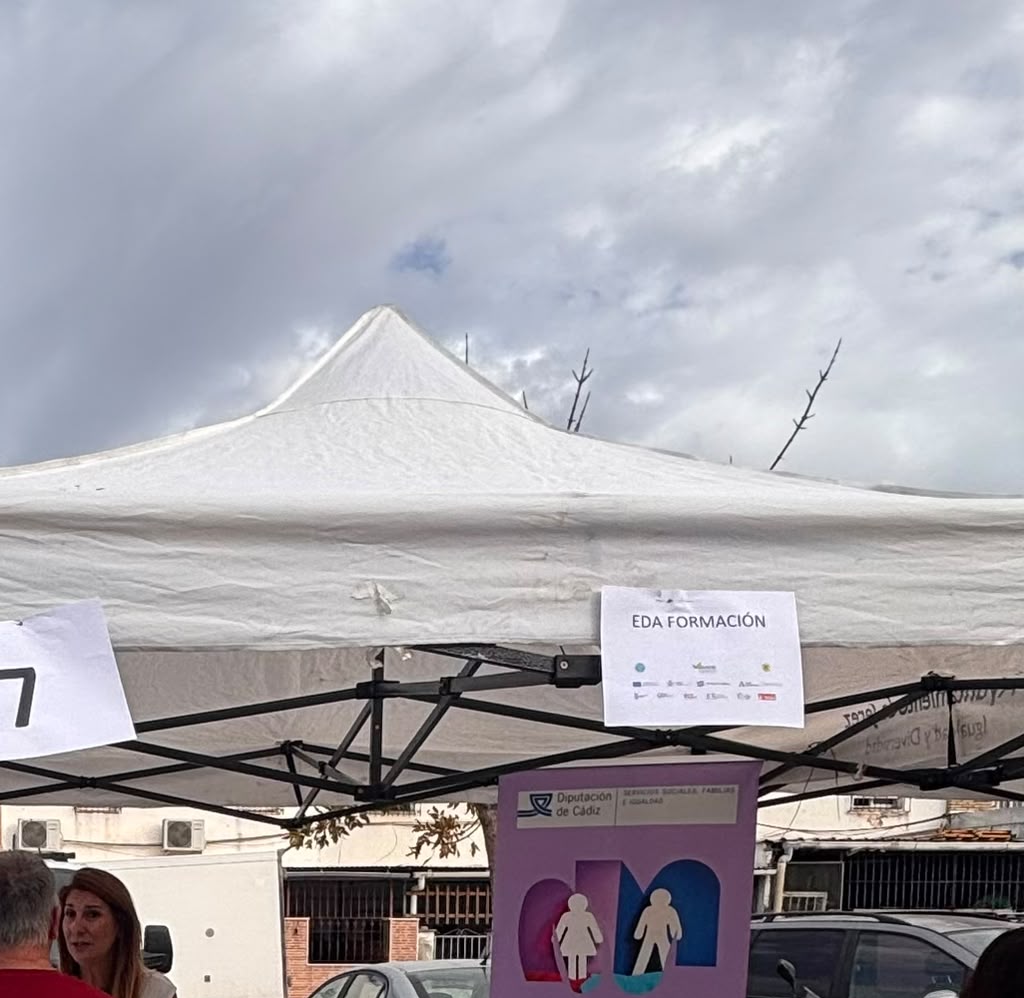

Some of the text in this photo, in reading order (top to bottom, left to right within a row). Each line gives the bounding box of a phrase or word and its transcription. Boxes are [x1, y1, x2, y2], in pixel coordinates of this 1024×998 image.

[632, 611, 766, 629] EDA FORMACIÓN
[556, 791, 613, 804] Diputación
[556, 804, 601, 818] de Cádiz
